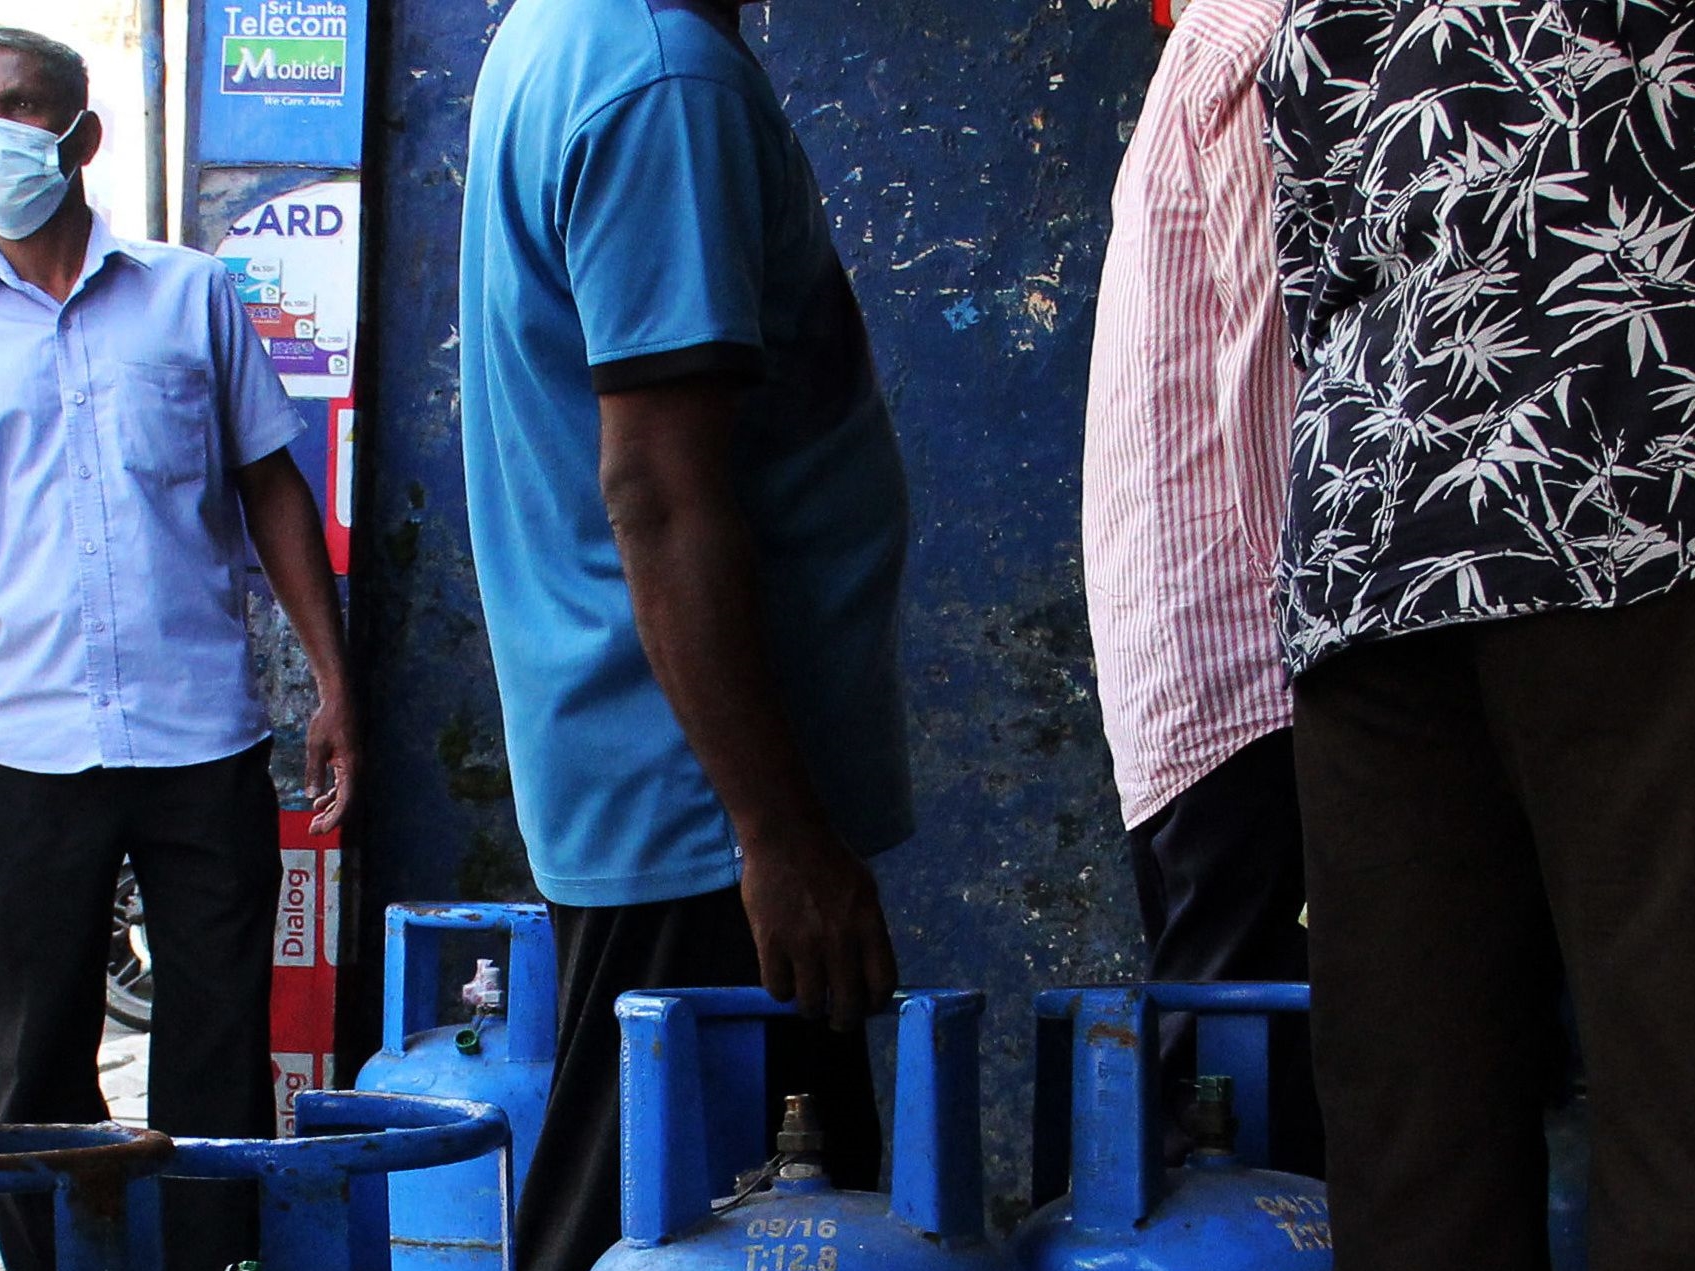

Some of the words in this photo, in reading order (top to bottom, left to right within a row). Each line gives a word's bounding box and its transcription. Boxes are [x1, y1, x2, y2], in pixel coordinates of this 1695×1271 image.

[223, 3, 347, 36] Telecom
[268, 1, 292, 16] Sri
[296, 1, 347, 16] Lanka
[231, 47, 336, 83] Mobitel
[282, 868, 311, 957] Dialog
[746, 1218, 838, 1239] 09/16
